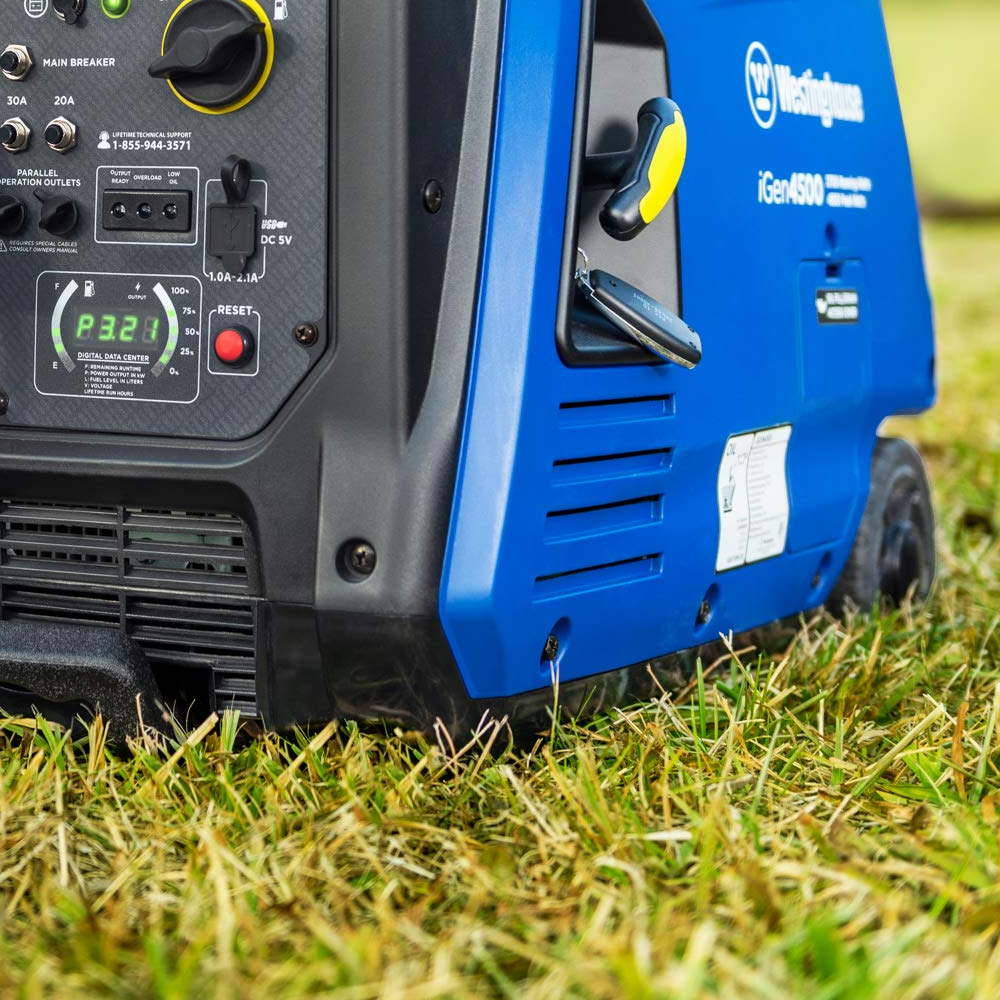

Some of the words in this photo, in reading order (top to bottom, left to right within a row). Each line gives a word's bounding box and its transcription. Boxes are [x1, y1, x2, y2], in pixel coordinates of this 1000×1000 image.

[43, 58, 68, 67] MAIN
[71, 58, 115, 67] BREAKER
[7, 96, 27, 106] 30A
[54, 96, 75, 106] 20A
[774, 64, 865, 128] Westinghouse
[113, 140, 190, 150] 1-855-944-3571
[758, 170, 824, 206] iGen4500
[261, 219, 277, 229] USB
[261, 235, 276, 244] DC
[278, 235, 292, 245] 5V
[209, 272, 258, 283] 1.0A-2.1A
[218, 305, 252, 315] RESET
[169, 367, 179, 375] 0%
